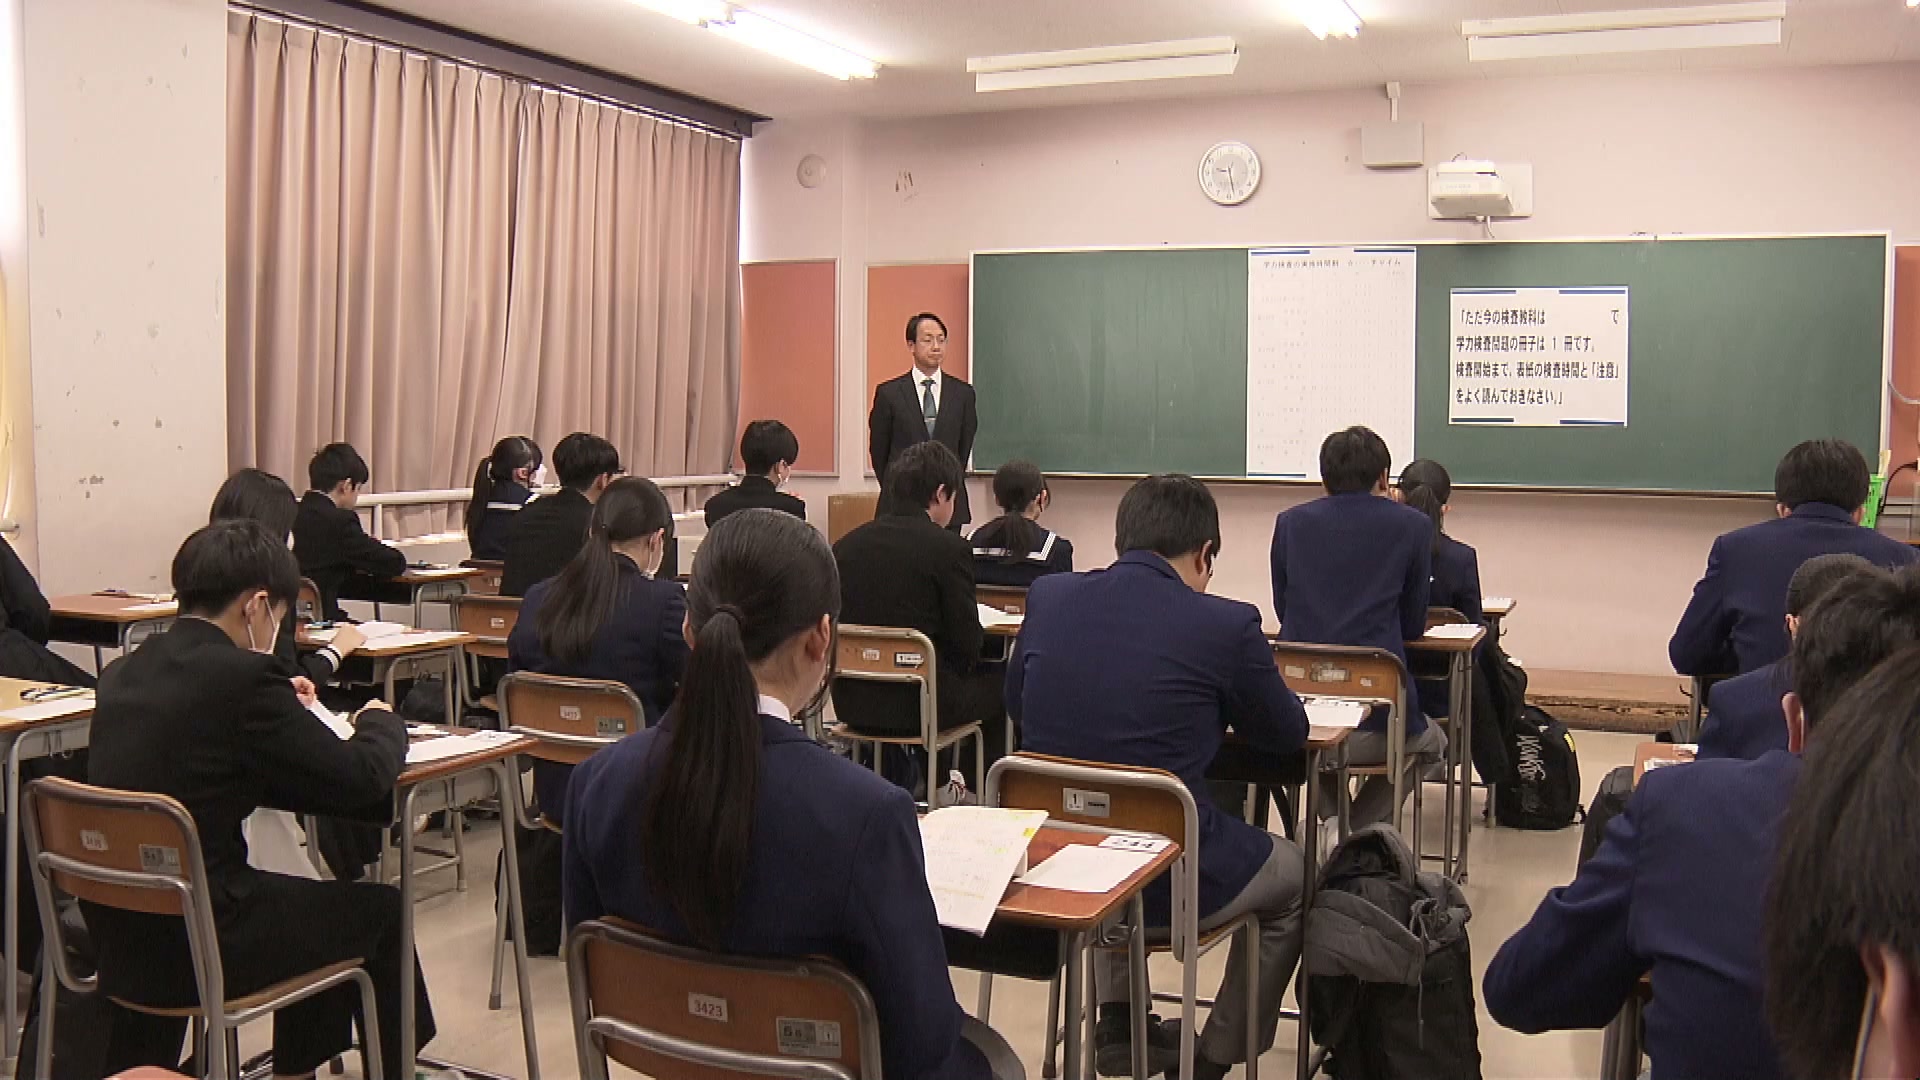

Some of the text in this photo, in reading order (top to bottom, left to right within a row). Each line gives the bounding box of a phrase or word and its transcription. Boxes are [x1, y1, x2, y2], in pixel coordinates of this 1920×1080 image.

[1461, 308, 1545, 326] 「ただ今の検査教科は
[1456, 335, 1545, 352] 学力検査問題の冊子は
[694, 999, 723, 1017] 3423
